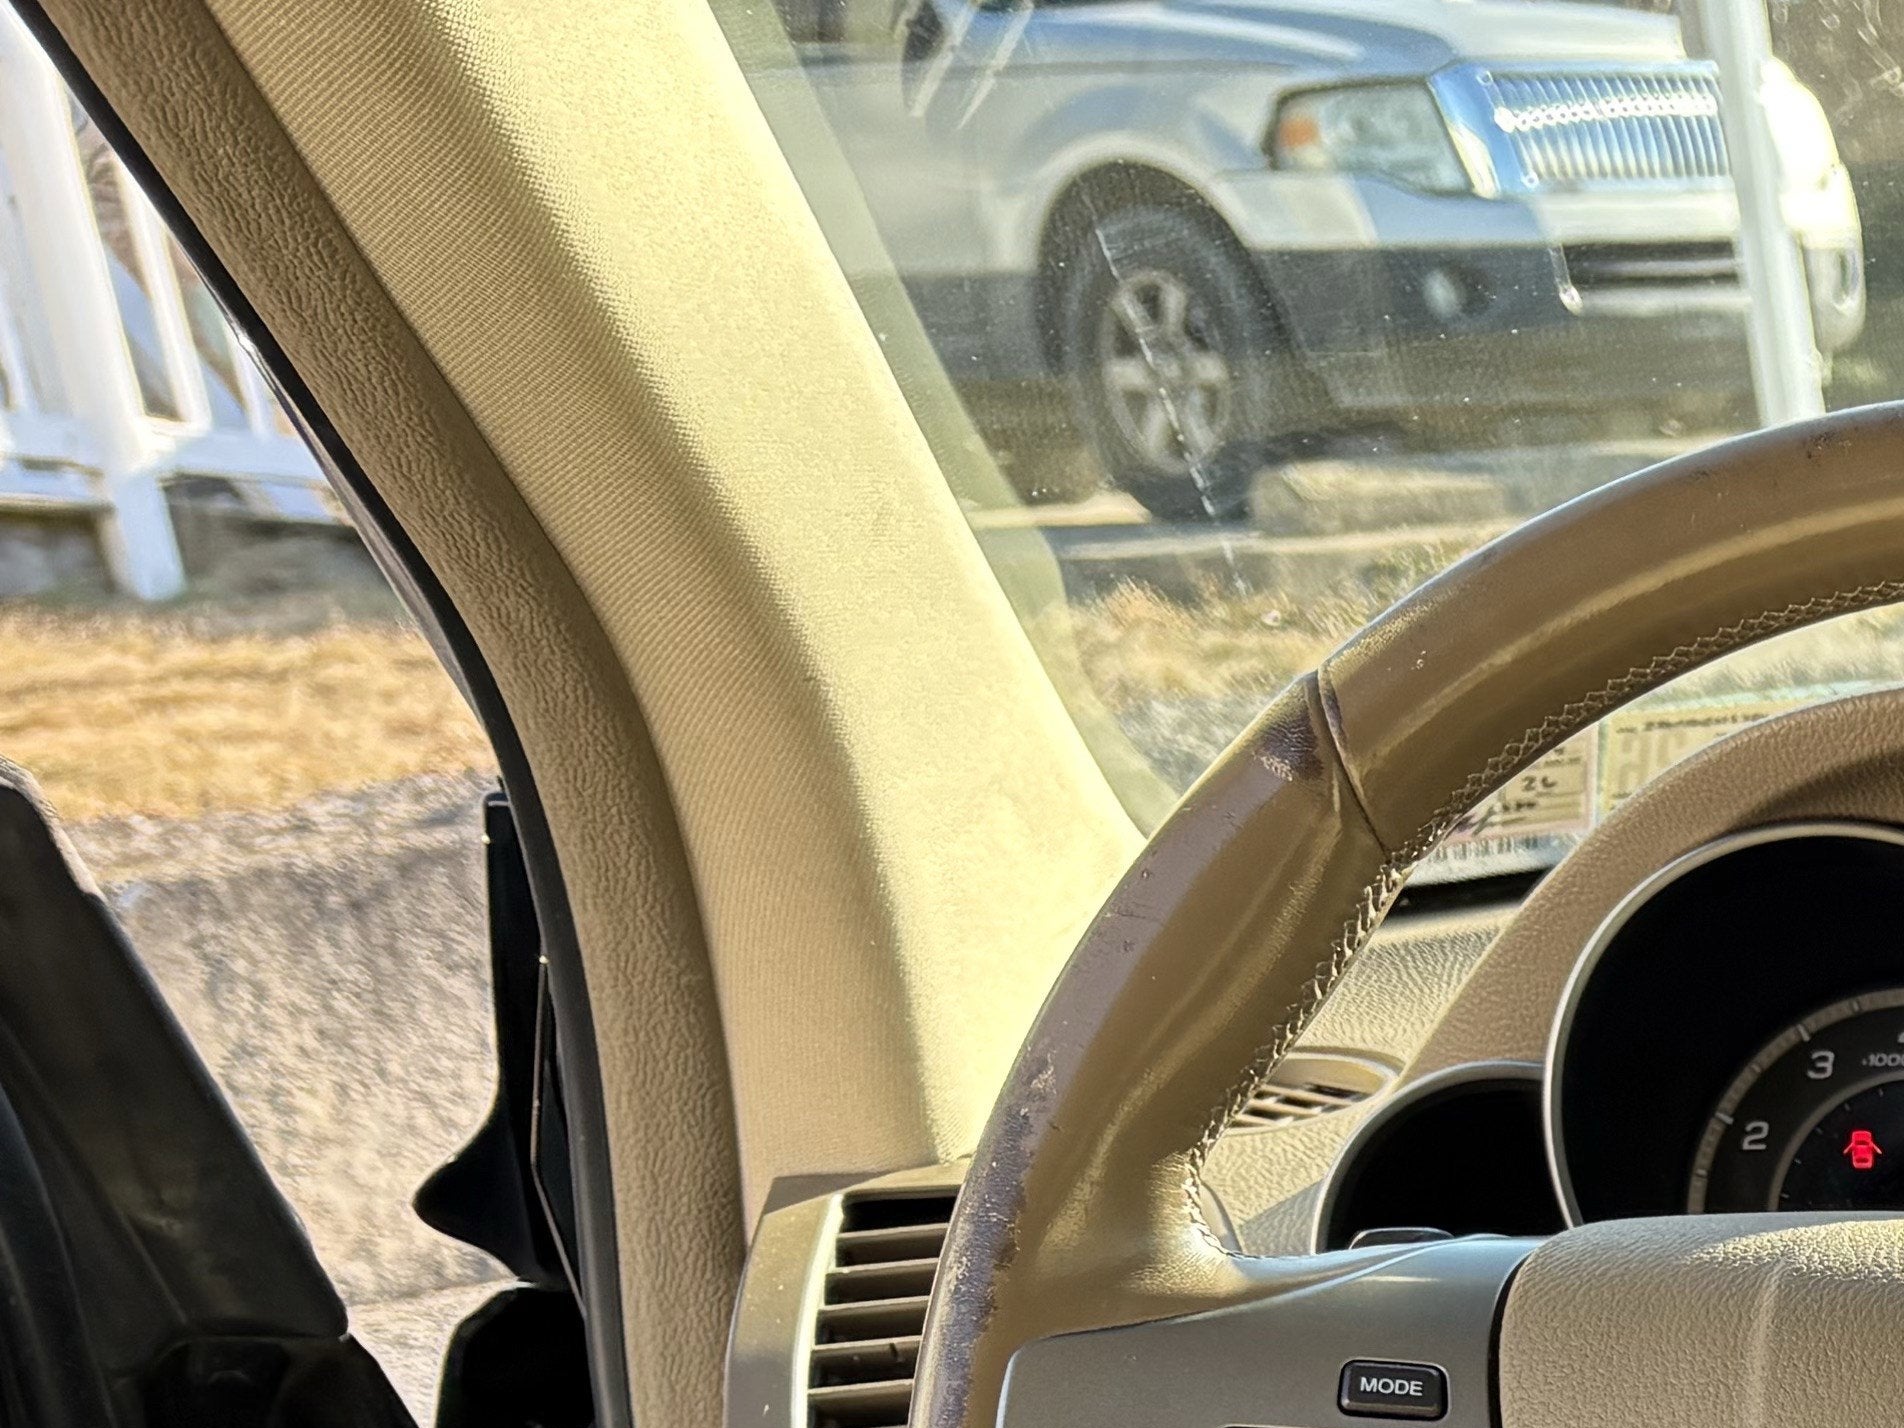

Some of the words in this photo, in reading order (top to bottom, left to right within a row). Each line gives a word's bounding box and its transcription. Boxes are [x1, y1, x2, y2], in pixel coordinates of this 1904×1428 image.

[1807, 1052, 1835, 1079] 3
[1741, 1121, 1769, 1151] 2
[1360, 1376, 1423, 1397] MODE
